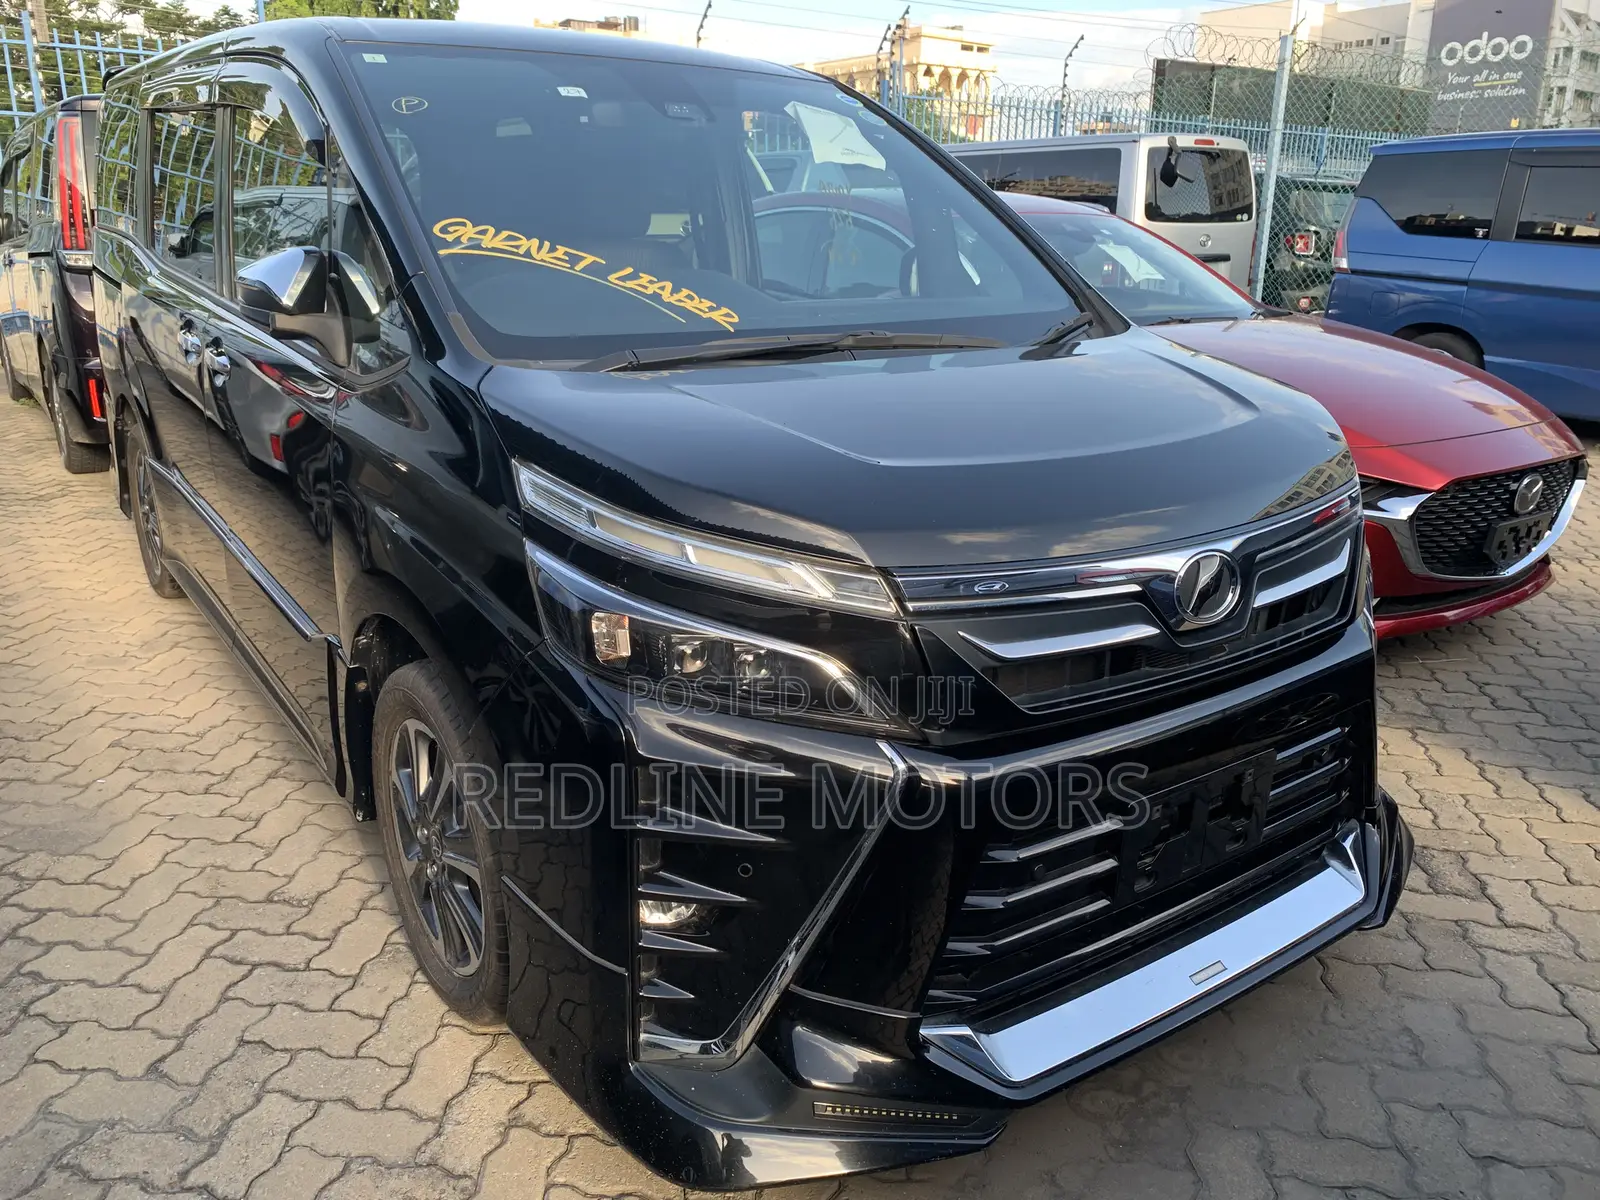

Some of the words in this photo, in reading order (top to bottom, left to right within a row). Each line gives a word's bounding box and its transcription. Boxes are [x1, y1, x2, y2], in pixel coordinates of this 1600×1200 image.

[1440, 31, 1534, 66] odoo
[1447, 72, 1471, 85] Your
[1473, 69, 1488, 82] all
[1489, 70, 1500, 81] in
[1503, 71, 1523, 80] one
[1437, 88, 1481, 101] business
[1484, 85, 1527, 98] solution
[432, 217, 606, 271] GARNET
